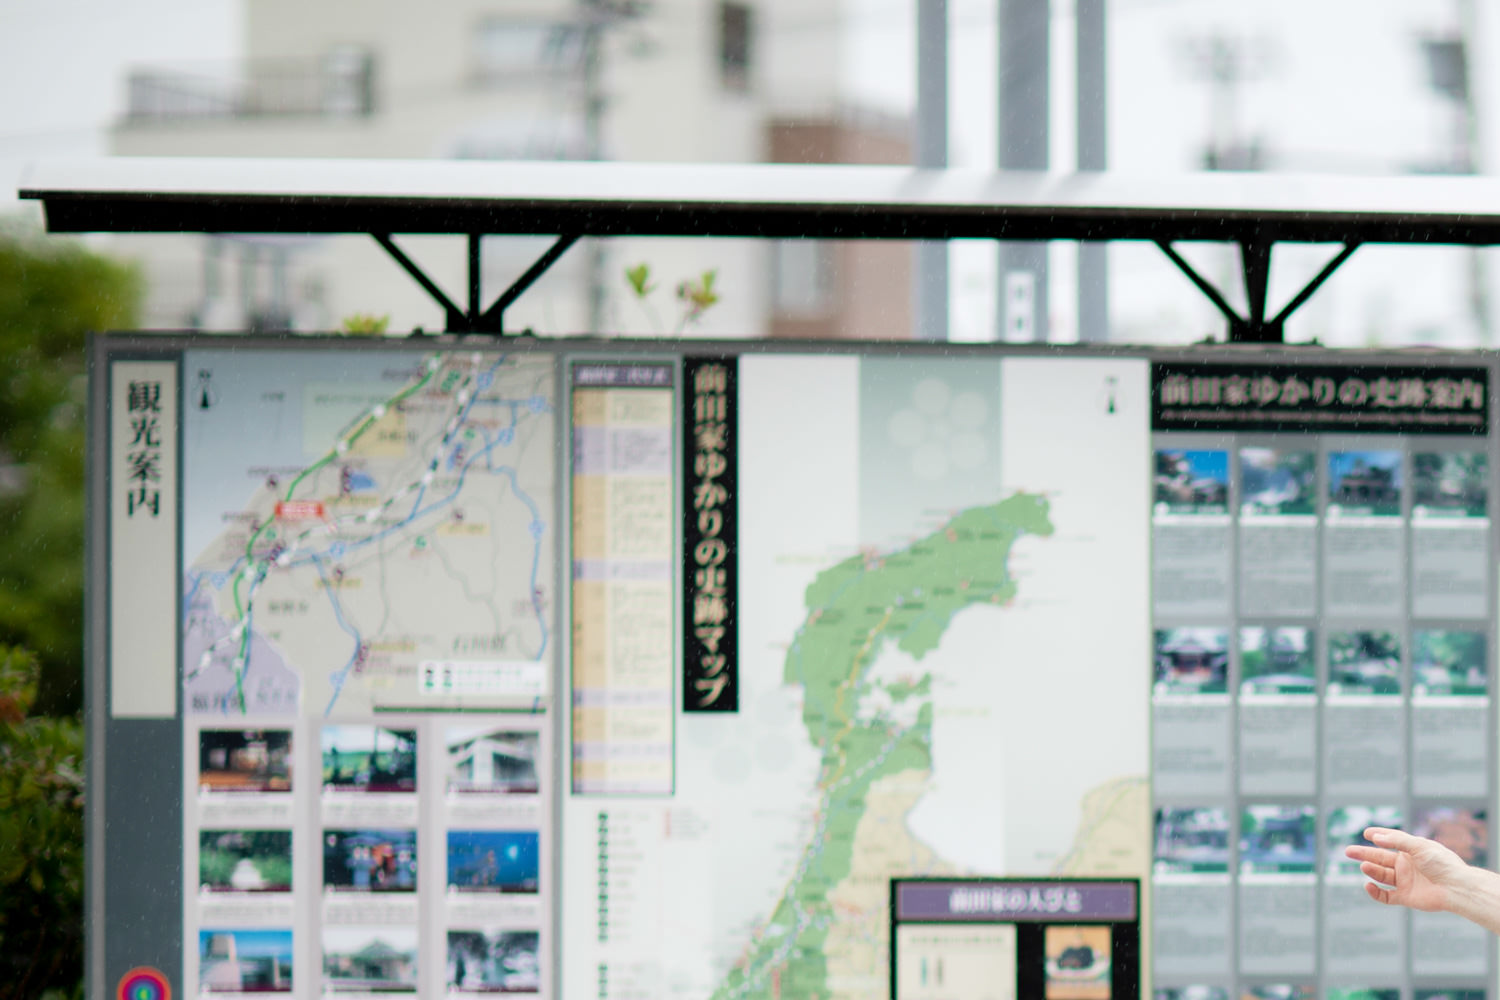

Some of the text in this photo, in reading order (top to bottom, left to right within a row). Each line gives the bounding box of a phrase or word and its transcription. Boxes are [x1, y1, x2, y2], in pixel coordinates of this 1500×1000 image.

[1161, 374, 1484, 408] 前田家ゆかりの史跡案内
[127, 378, 161, 518] 観光案内
